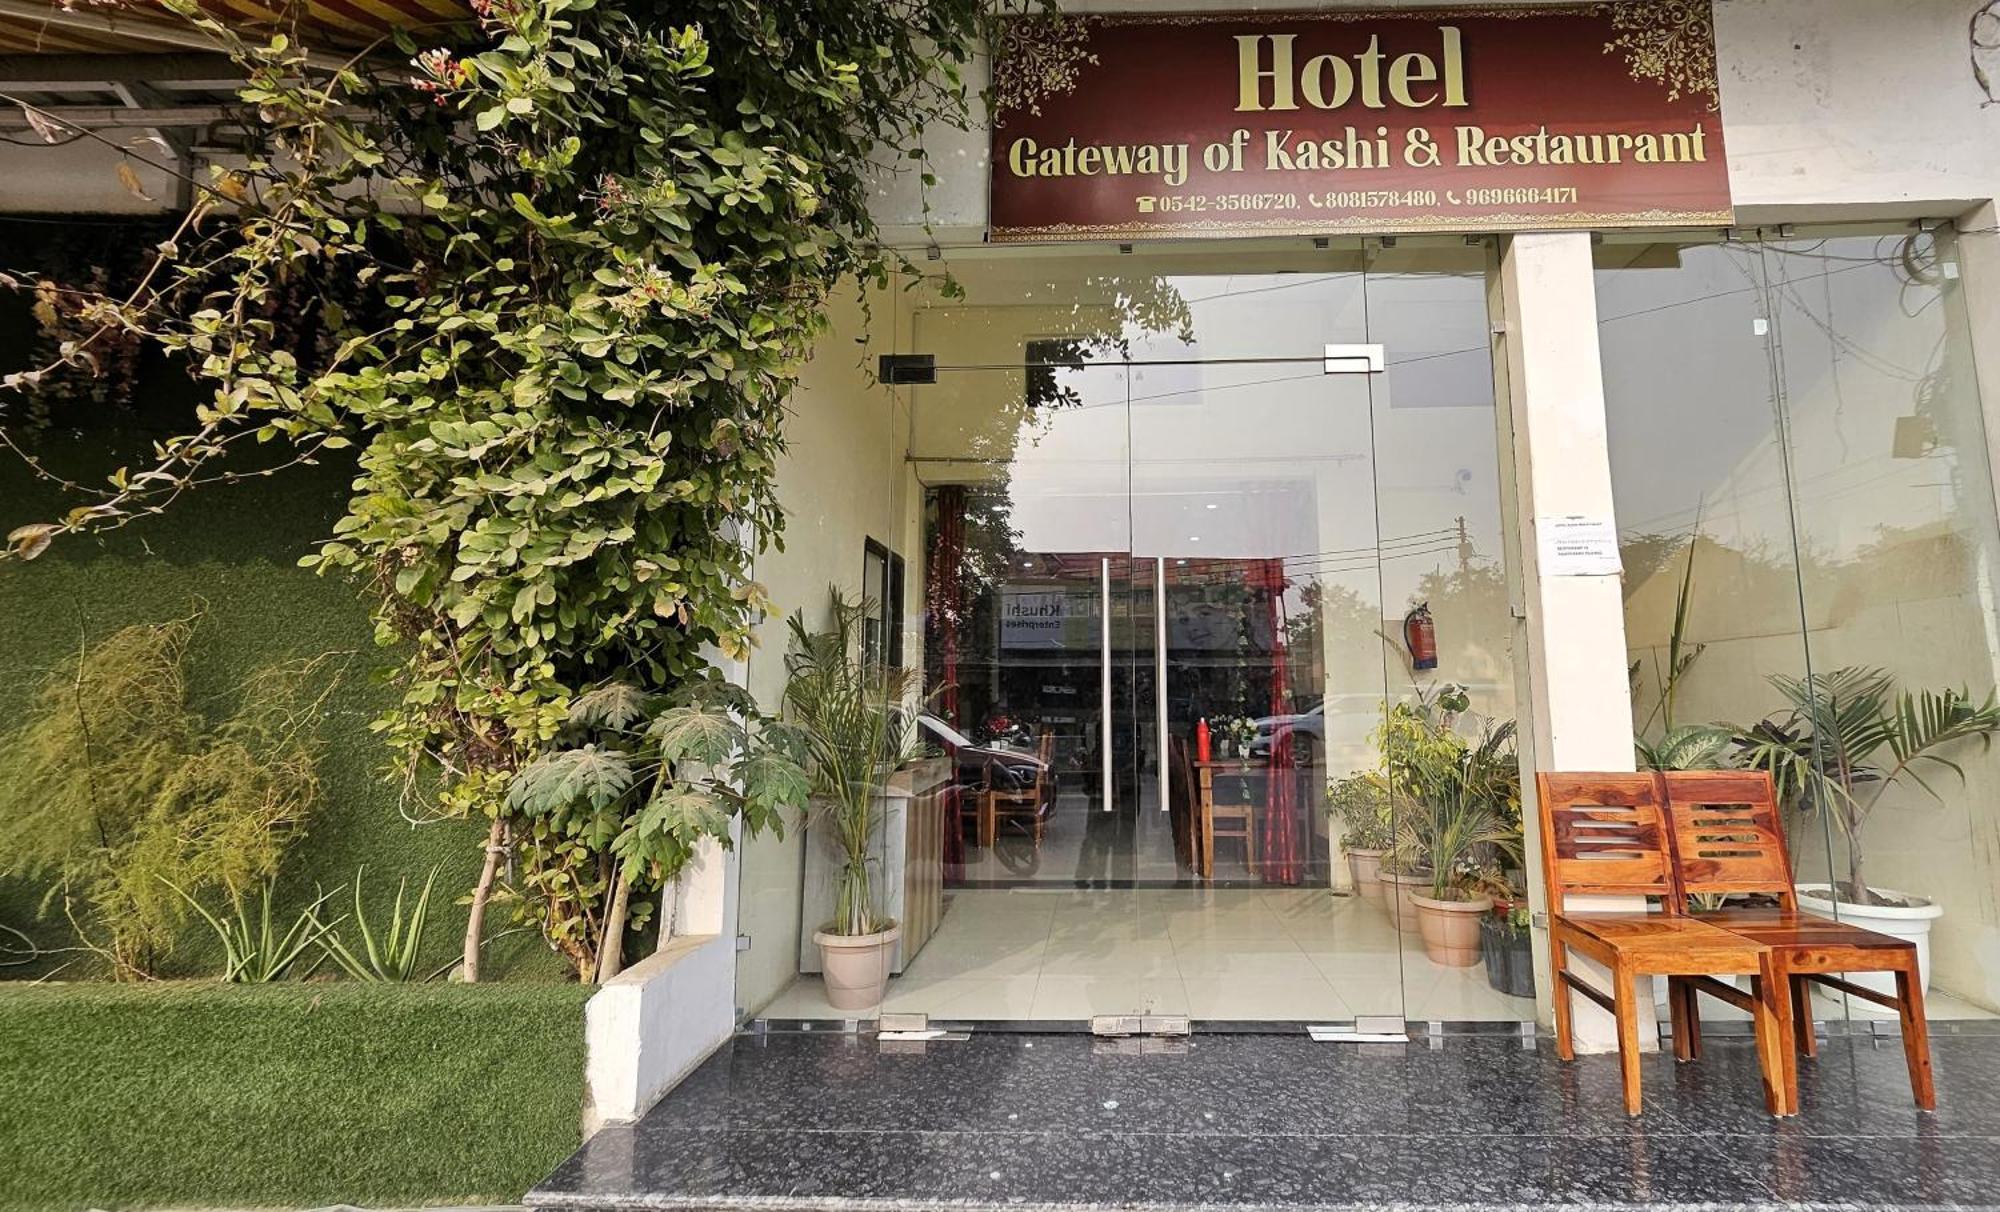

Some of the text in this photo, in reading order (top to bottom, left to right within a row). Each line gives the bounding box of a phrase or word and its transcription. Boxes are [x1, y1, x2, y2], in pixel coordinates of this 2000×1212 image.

[1233, 26, 1470, 113] Hotel
[1009, 123, 1707, 186] Gateway of Kashi & Restaurant
[1466, 187, 1578, 205] 9696664171
